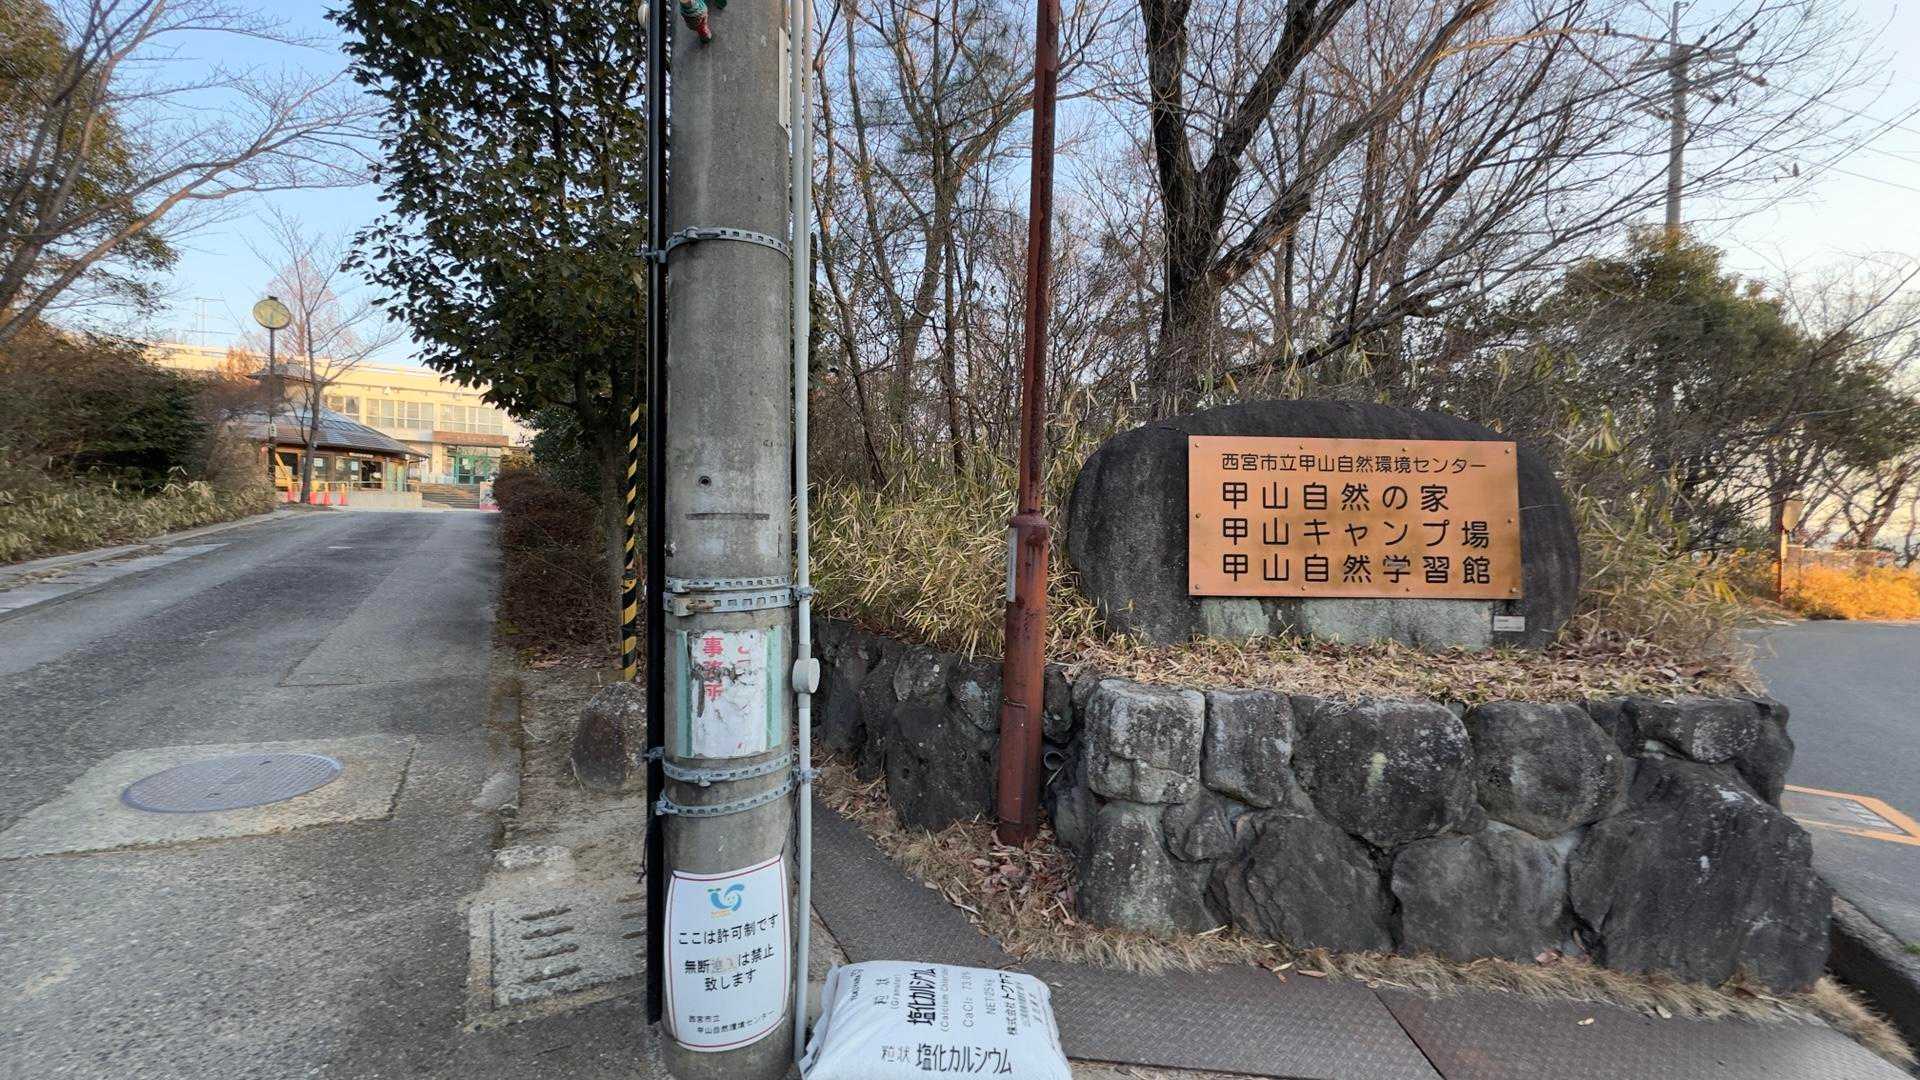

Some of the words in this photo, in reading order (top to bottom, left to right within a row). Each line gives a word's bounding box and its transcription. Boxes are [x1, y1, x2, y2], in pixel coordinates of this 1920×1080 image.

[1221, 453, 1487, 474] 西宮市立甲山自然環境センター
[1222, 481, 1449, 512] 甲山自然の家
[1222, 517, 1490, 549] 甲山キャンプ場
[1222, 553, 1491, 585] 甲山自然学習館
[678, 912, 779, 945] ここは許可制です
[684, 944, 775, 974] 無断は禁止
[704, 968, 756, 992] 致します
[906, 967, 936, 1027] 塩化カルシウム
[915, 1042, 1012, 1075] 塩化カルシウム
